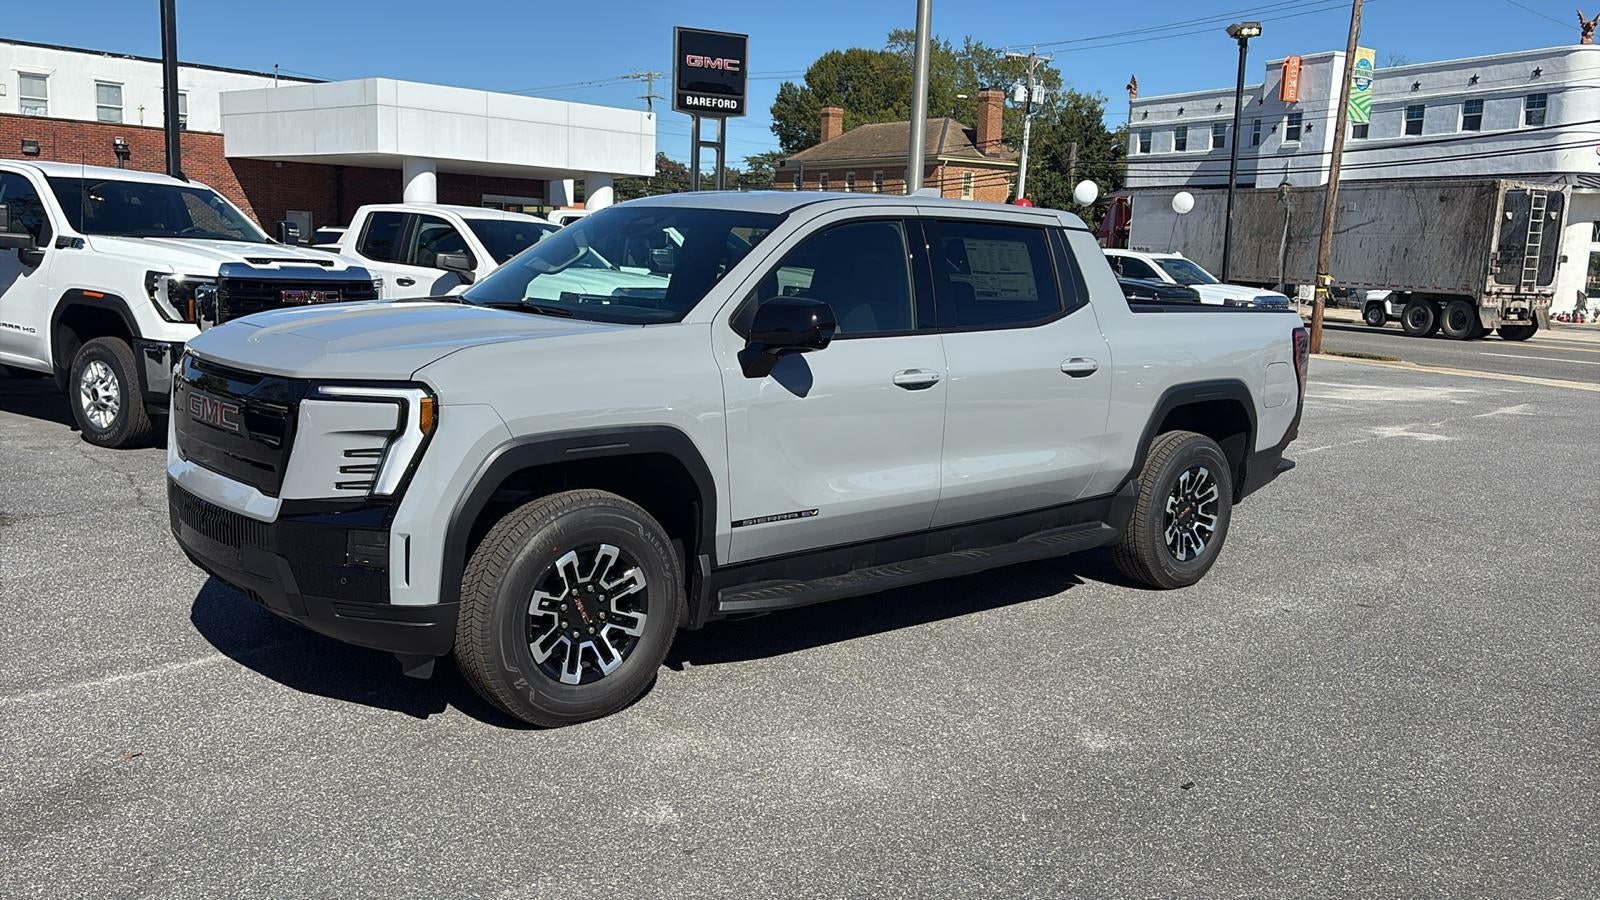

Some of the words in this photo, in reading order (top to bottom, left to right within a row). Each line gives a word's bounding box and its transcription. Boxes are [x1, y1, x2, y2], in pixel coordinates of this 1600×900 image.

[686, 54, 740, 71] GMC
[686, 95, 737, 109] BAREFORD
[280, 290, 340, 303] GMC
[188, 391, 240, 431] GMC
[742, 513, 799, 527] SIERRA
